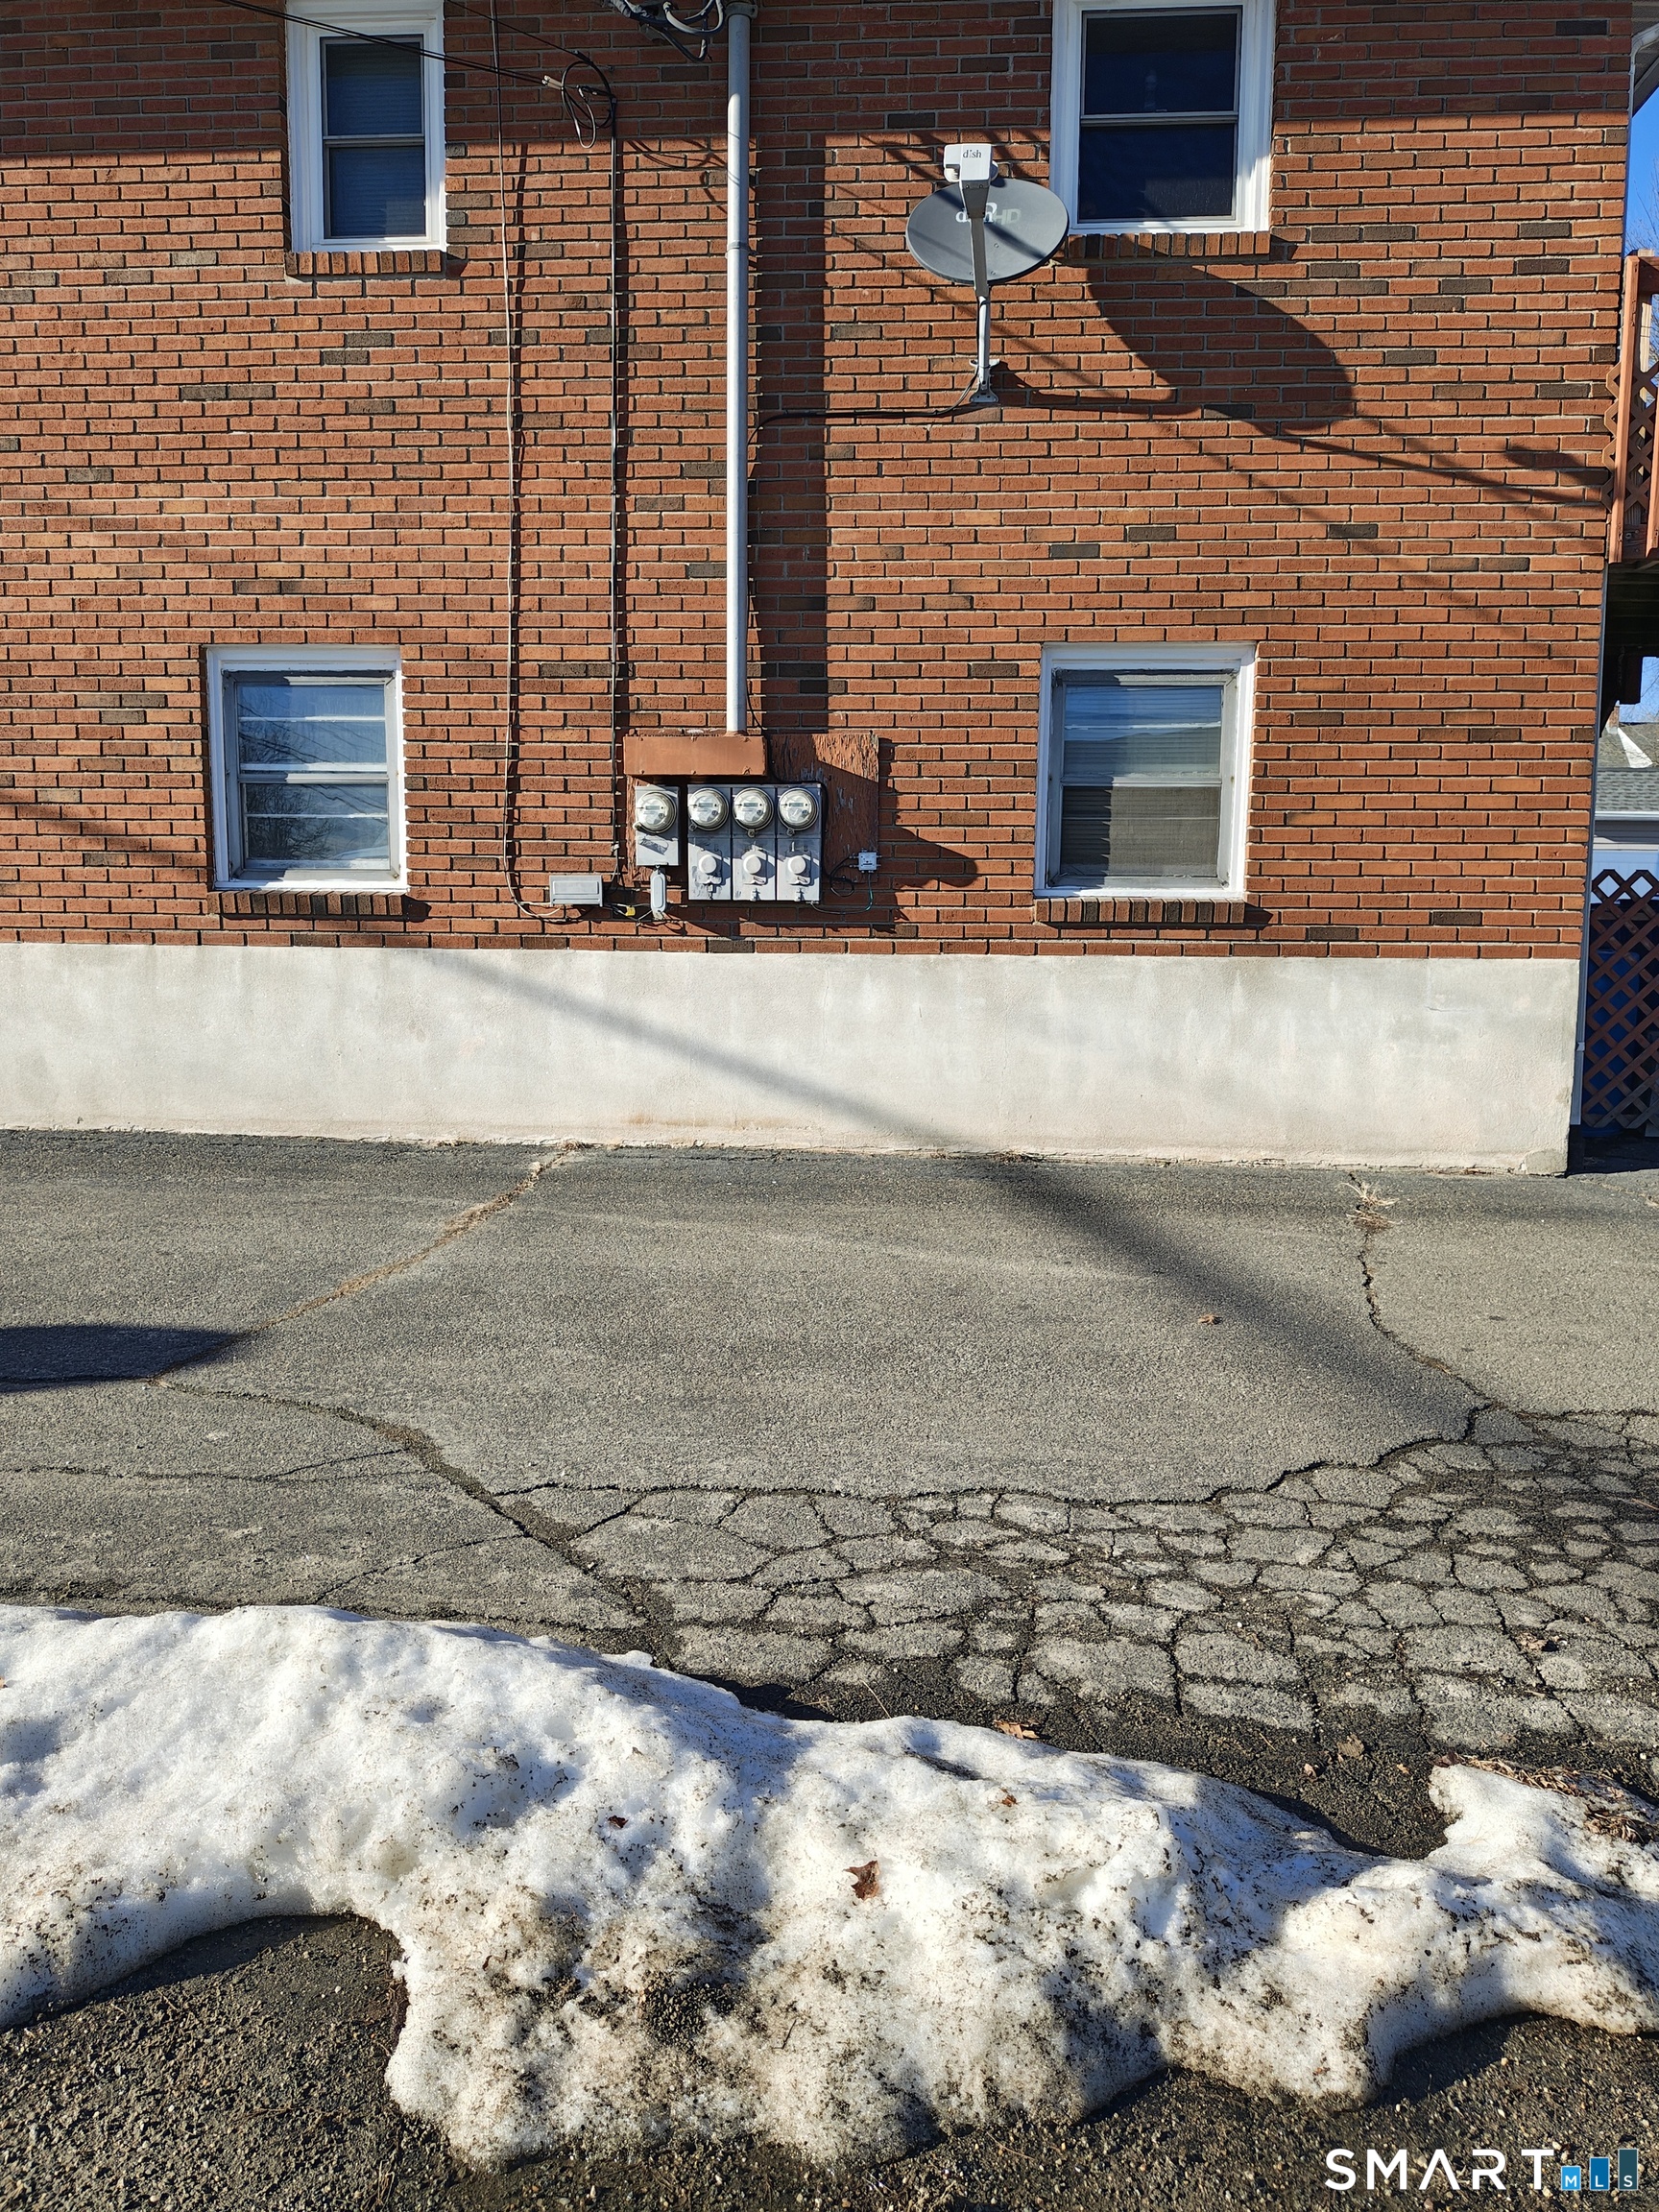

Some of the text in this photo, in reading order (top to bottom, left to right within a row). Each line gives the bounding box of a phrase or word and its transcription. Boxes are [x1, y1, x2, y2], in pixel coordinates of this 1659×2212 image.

[962, 149, 982, 158] dish
[955, 207, 1021, 225] dh HD
